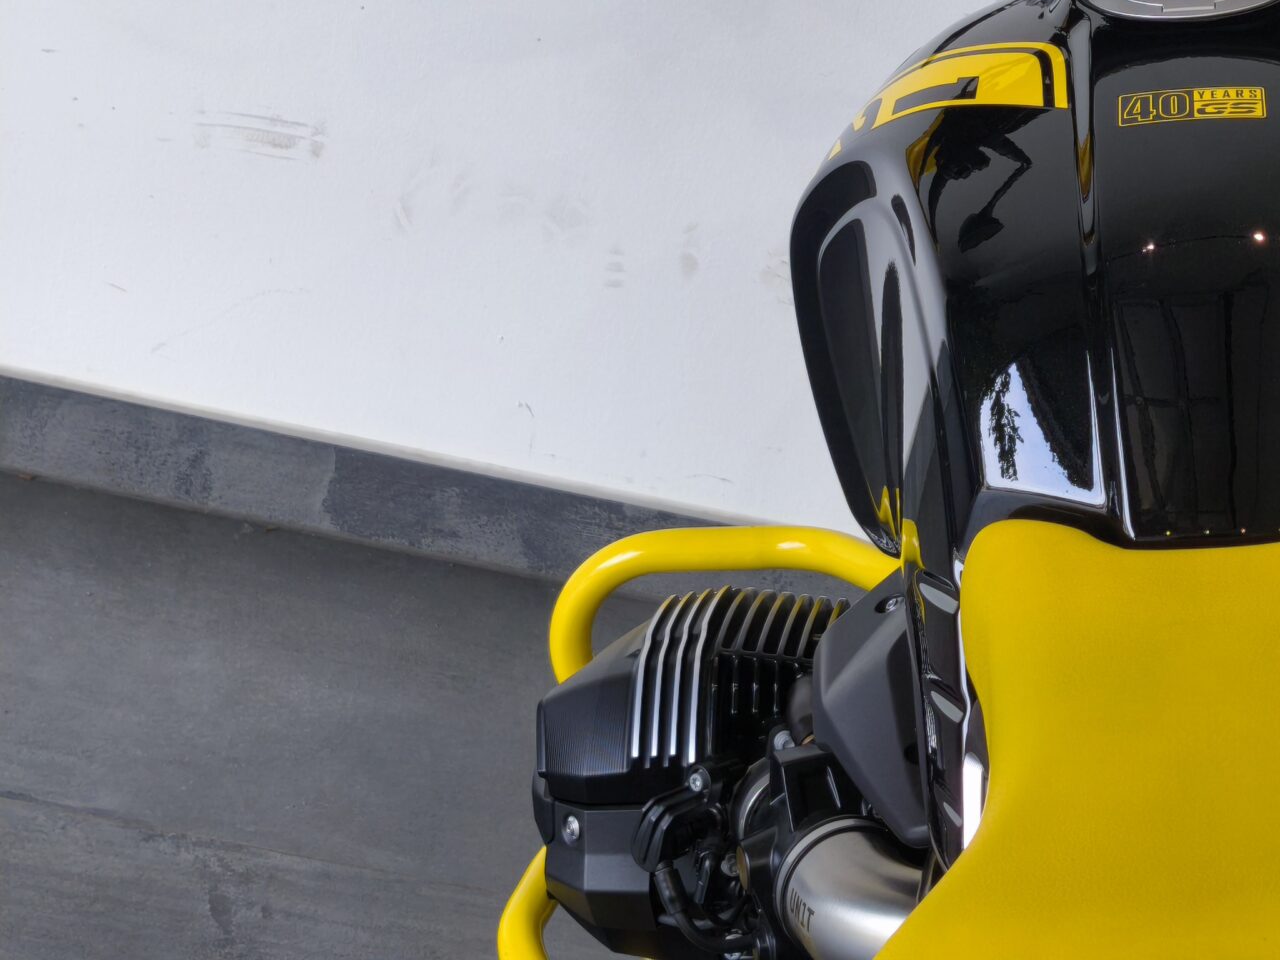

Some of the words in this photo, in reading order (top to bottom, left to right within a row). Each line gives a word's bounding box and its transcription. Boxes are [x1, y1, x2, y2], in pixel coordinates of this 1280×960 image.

[1124, 92, 1190, 122] 40
[1197, 90, 1258, 99] YEARS
[1196, 102, 1259, 115] GS
[790, 888, 815, 933] UNIT
